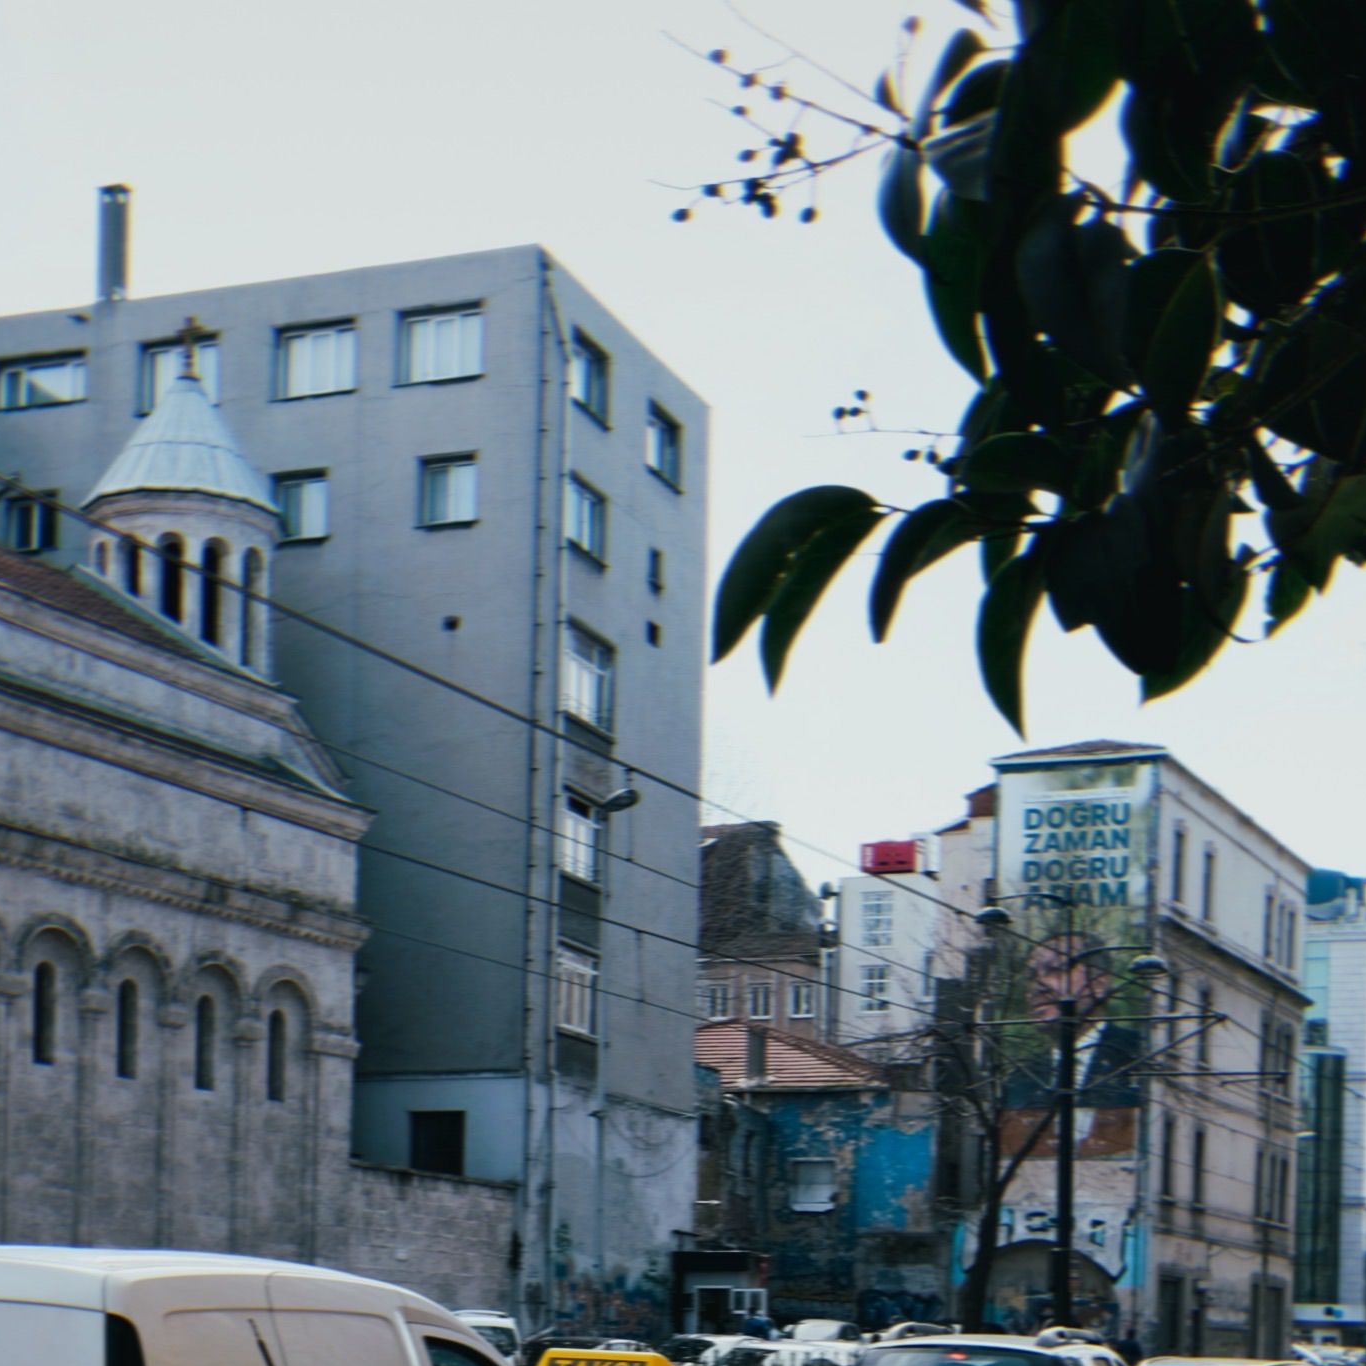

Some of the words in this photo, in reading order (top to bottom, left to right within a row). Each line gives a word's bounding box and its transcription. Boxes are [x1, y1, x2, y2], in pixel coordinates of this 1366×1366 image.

[1023, 802, 1130, 830] DOĞRU
[1023, 828, 1130, 854] ZAMAN
[1022, 855, 1130, 881] DOĞRU
